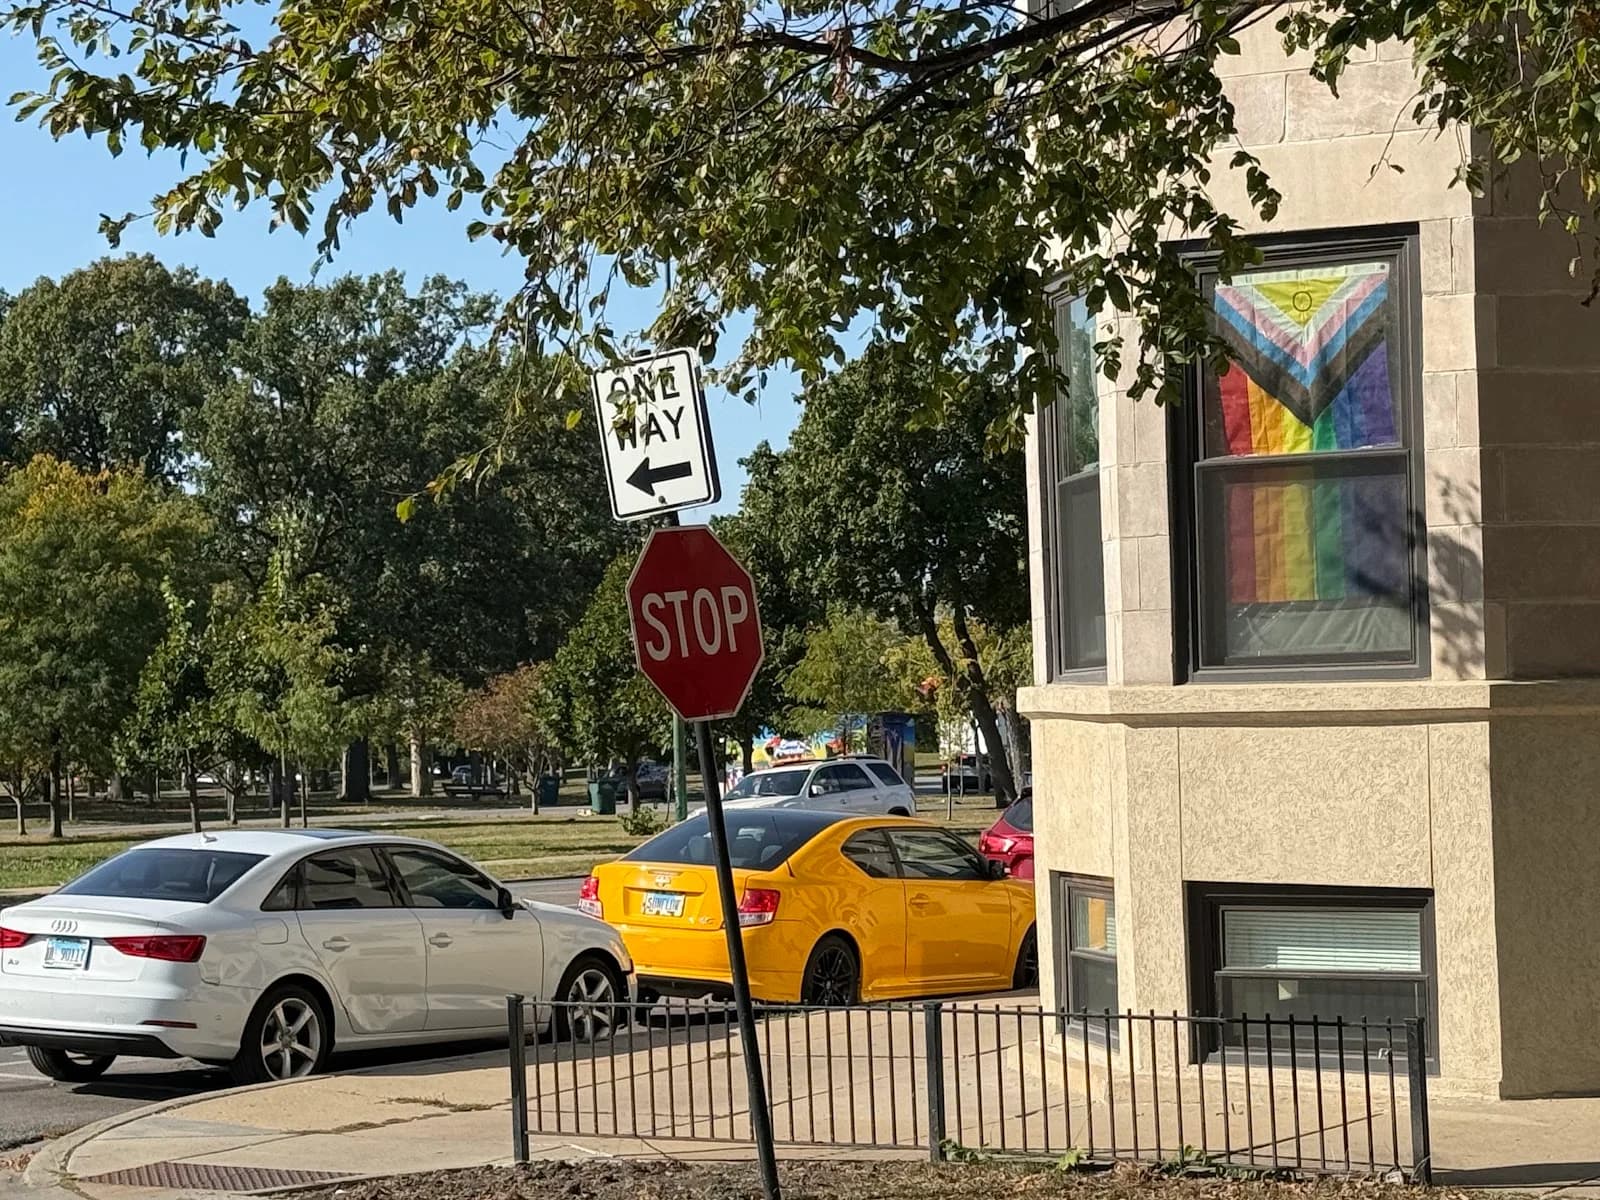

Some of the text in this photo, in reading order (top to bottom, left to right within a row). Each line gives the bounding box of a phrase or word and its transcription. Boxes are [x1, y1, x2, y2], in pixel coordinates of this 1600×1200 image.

[609, 366, 680, 407] ONE
[612, 406, 685, 451] WAY
[641, 585, 748, 661] STOP
